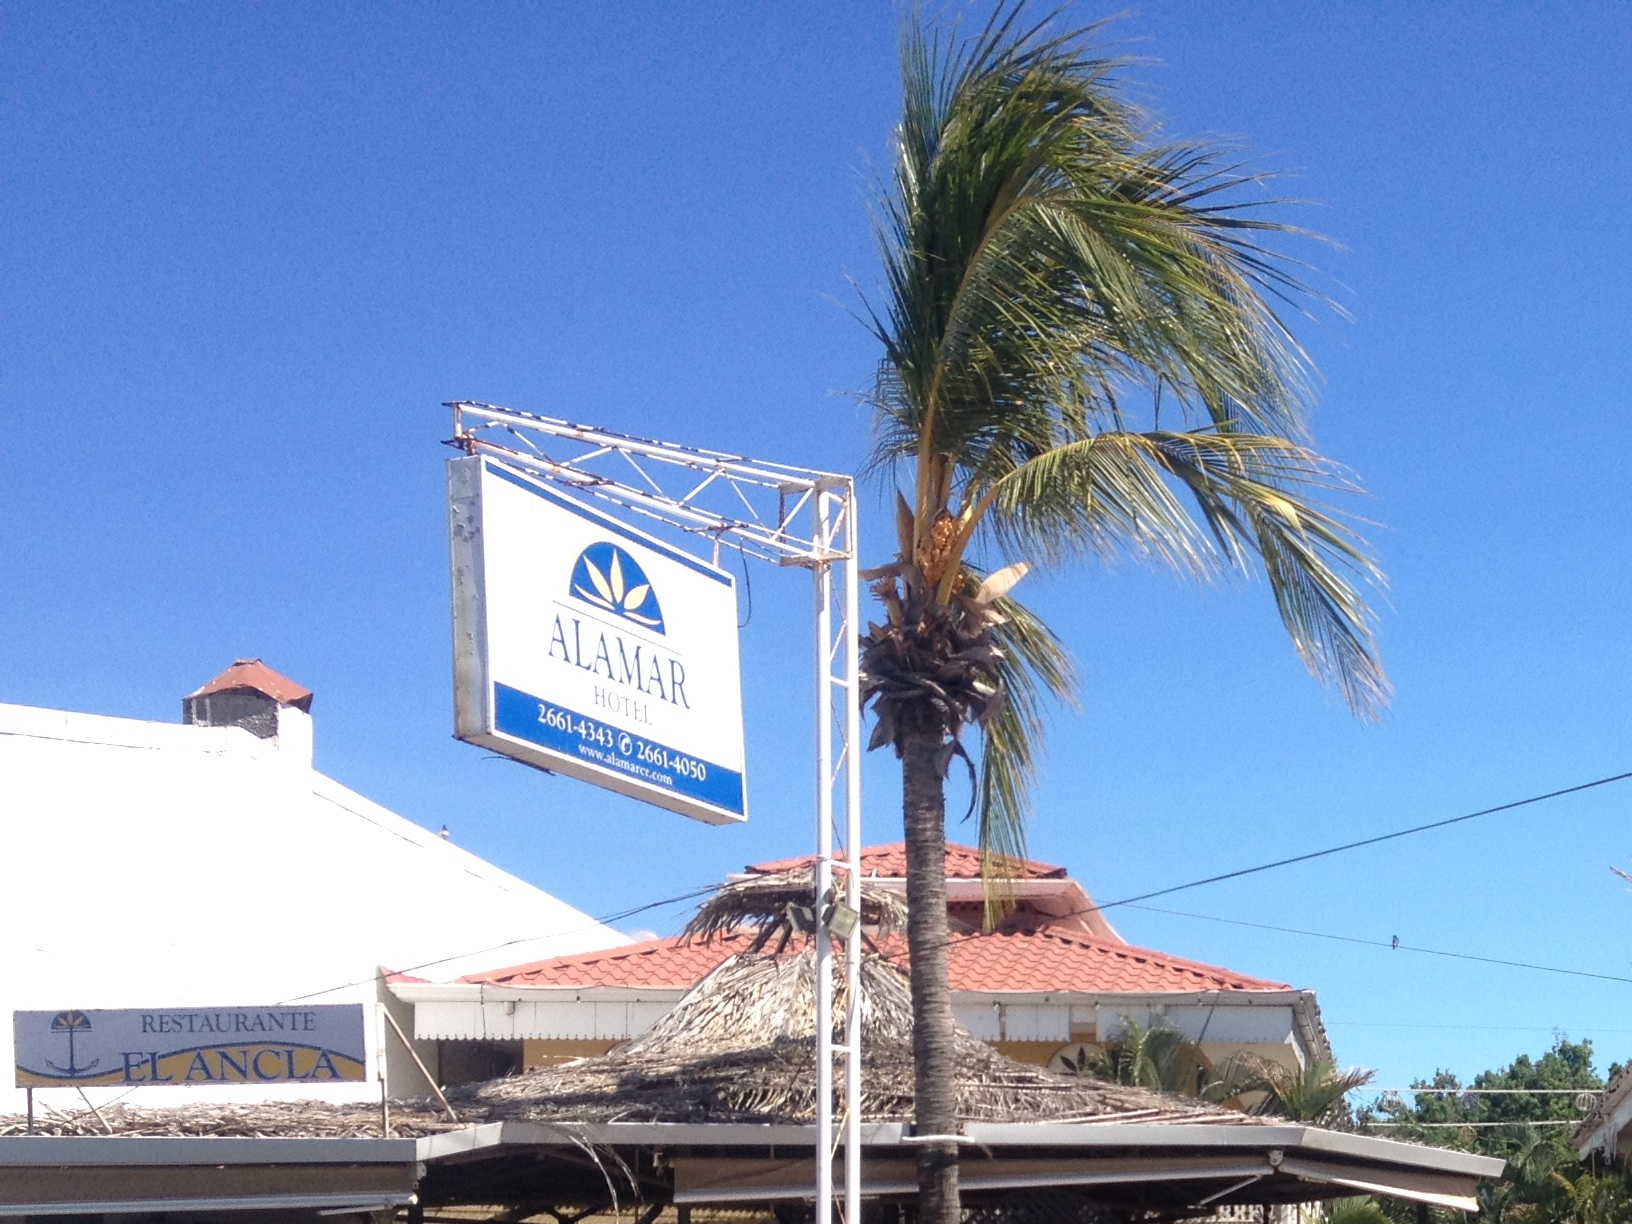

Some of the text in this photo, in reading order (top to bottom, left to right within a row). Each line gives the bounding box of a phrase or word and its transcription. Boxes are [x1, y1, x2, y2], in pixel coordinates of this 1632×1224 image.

[548, 612, 690, 710] ALAMAR
[594, 686, 653, 726] HOTEL
[537, 704, 706, 782] 2661-4343 2661-4050
[578, 743, 673, 786] www.alamarcr.com
[141, 1011, 316, 1033] RESTAURANTE
[122, 1049, 340, 1082] EL ANCLA
